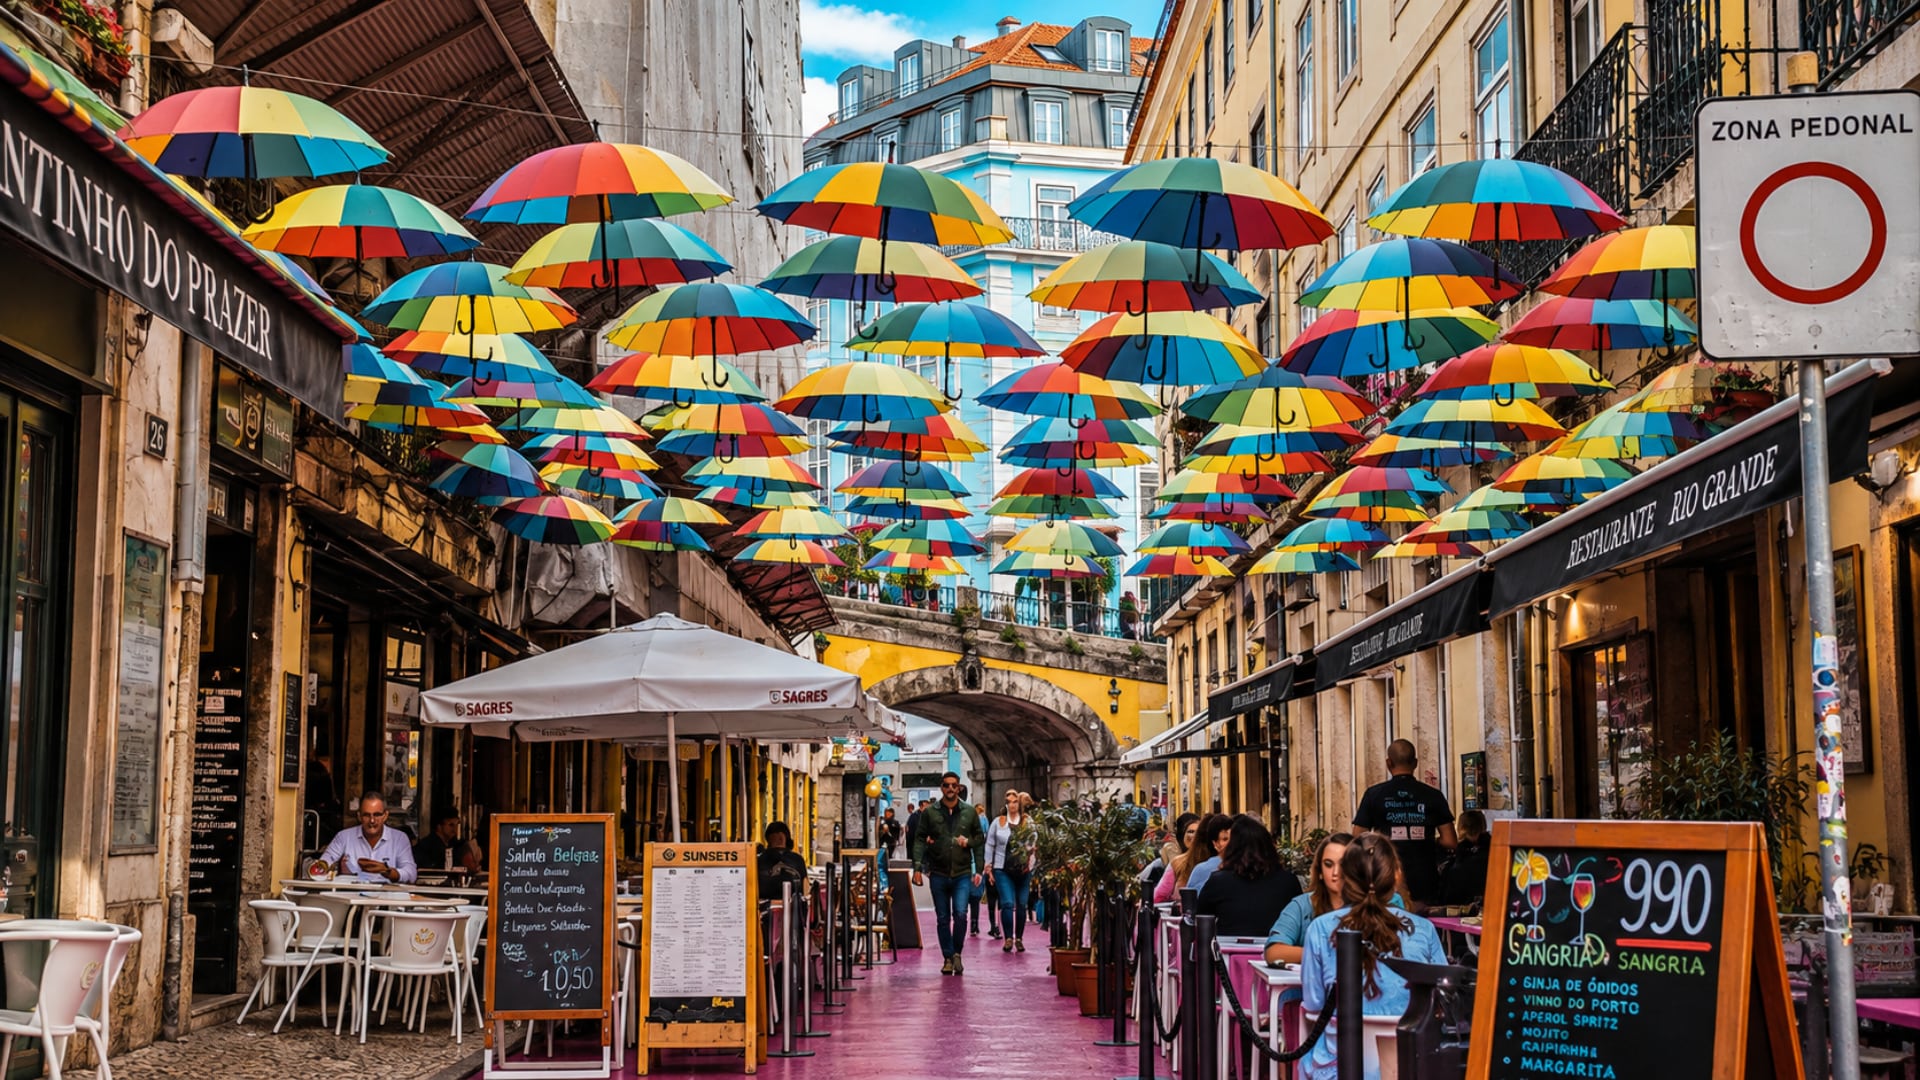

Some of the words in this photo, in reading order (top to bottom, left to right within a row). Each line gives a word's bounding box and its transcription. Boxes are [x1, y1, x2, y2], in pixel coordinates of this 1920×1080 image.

[1711, 119, 1781, 141] ZONA
[1790, 113, 1913, 137] PEDONAL
[0, 122, 134, 274] NTINHO
[142, 221, 180, 302] DO
[187, 250, 273, 361] PRAZER
[150, 421, 164, 451] 26
[1565, 501, 1657, 570] RESTAURANTE
[1668, 481, 1699, 526] RIO
[1702, 444, 1779, 511] GRANDE
[782, 689, 828, 704] SAGRES
[466, 701, 513, 716] SAGRES
[682, 851, 738, 861] SUNSETS
[1620, 858, 1712, 936] 990
[1507, 924, 1594, 967] SANGRIA
[1618, 952, 1705, 976] SANGRIA
[1523, 976, 1560, 990] GINJA
[1565, 979, 1582, 992] DE
[1523, 995, 1562, 1008] VINHO
[1568, 998, 1585, 1010] DO
[1591, 999, 1640, 1015] PORTO
[1522, 1011, 1568, 1025] APEROL
[1573, 1014, 1619, 1030] SPRITZ
[1522, 1027, 1569, 1040] MOJITO
[1520, 1057, 1616, 1079] MARGARITA
